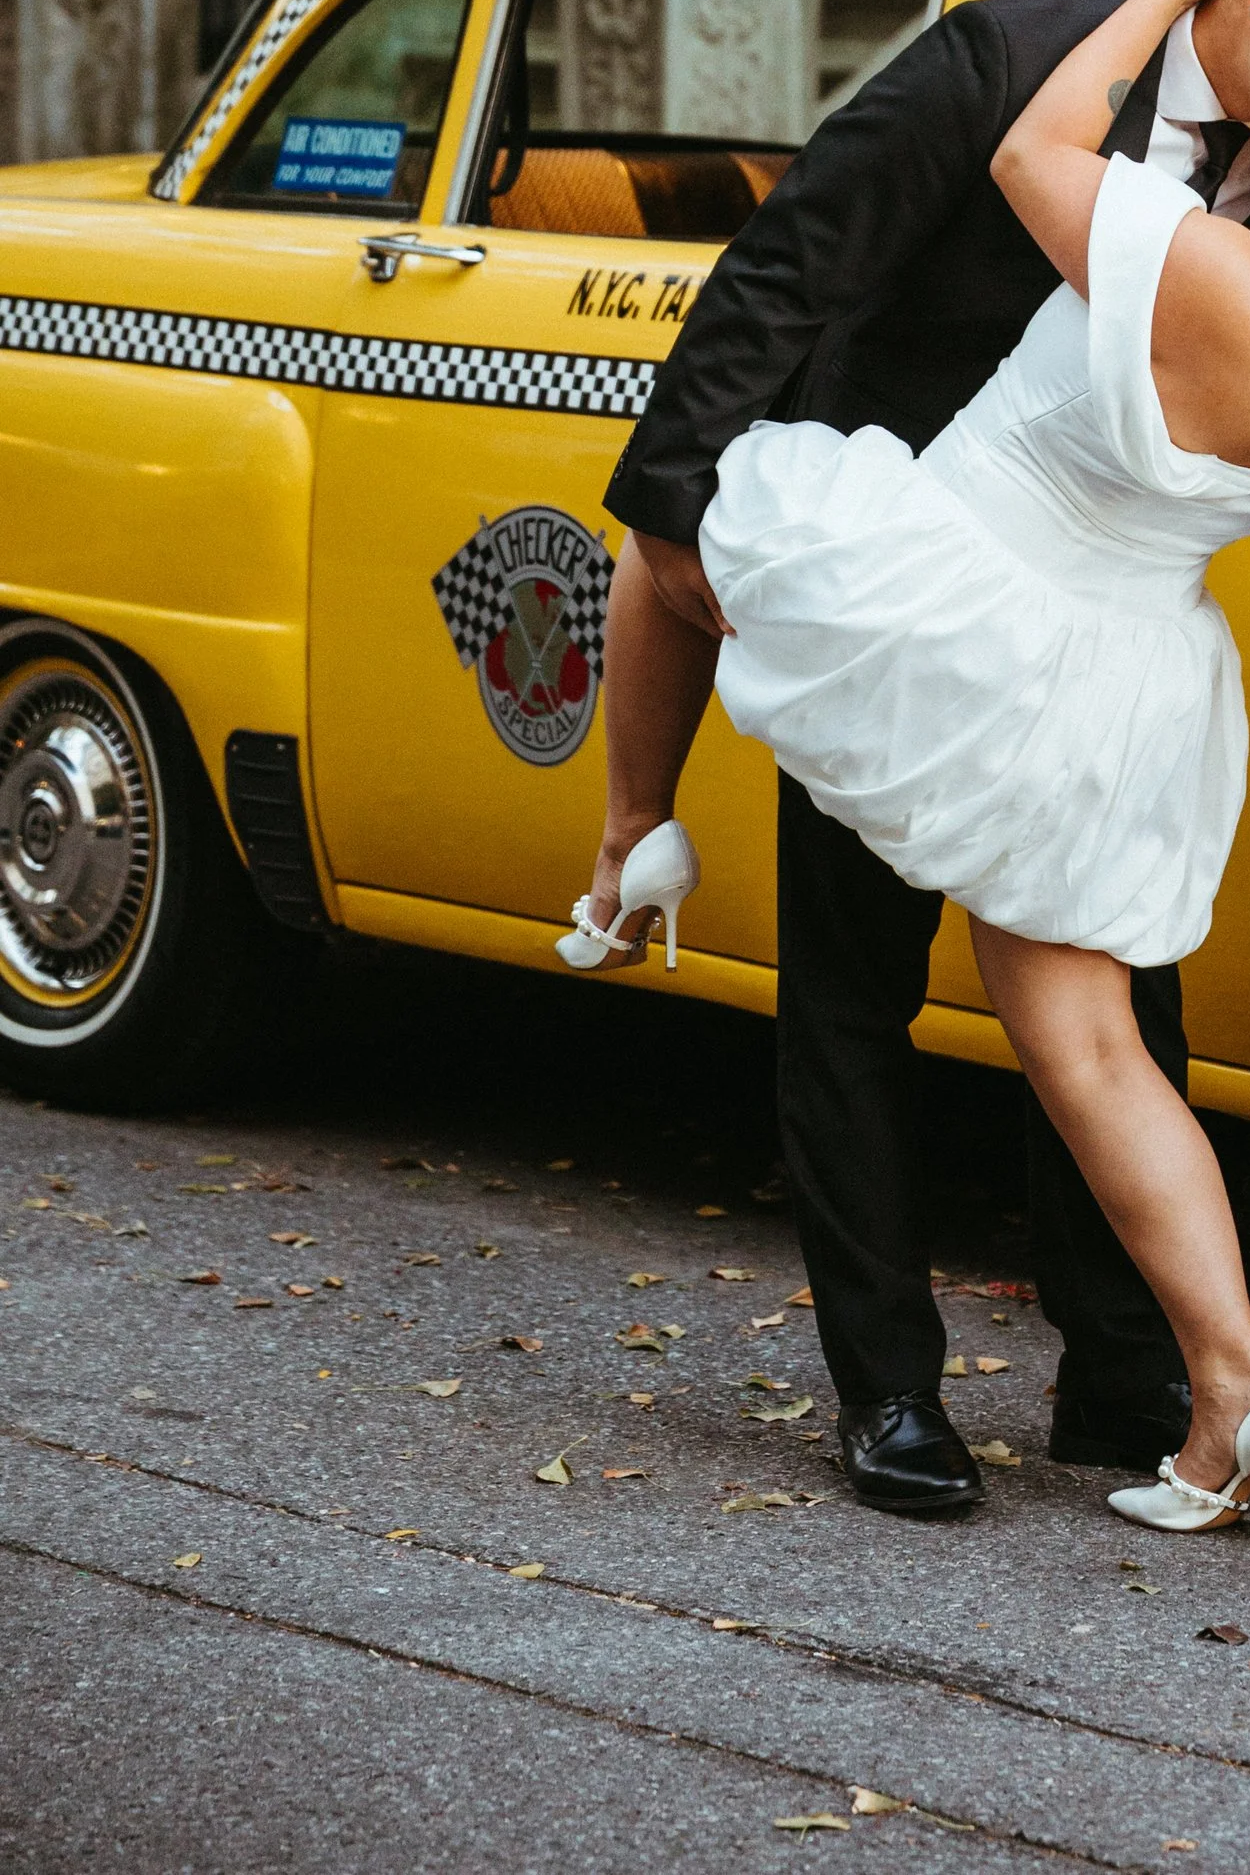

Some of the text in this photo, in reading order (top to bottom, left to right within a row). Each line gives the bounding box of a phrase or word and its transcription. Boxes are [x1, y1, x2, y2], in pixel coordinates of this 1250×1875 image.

[282, 124, 401, 158] AIR CONDITIONED
[566, 269, 647, 319] N.Y.C.
[494, 517, 589, 582] CHECKER
[500, 695, 577, 746] SPECIAL
